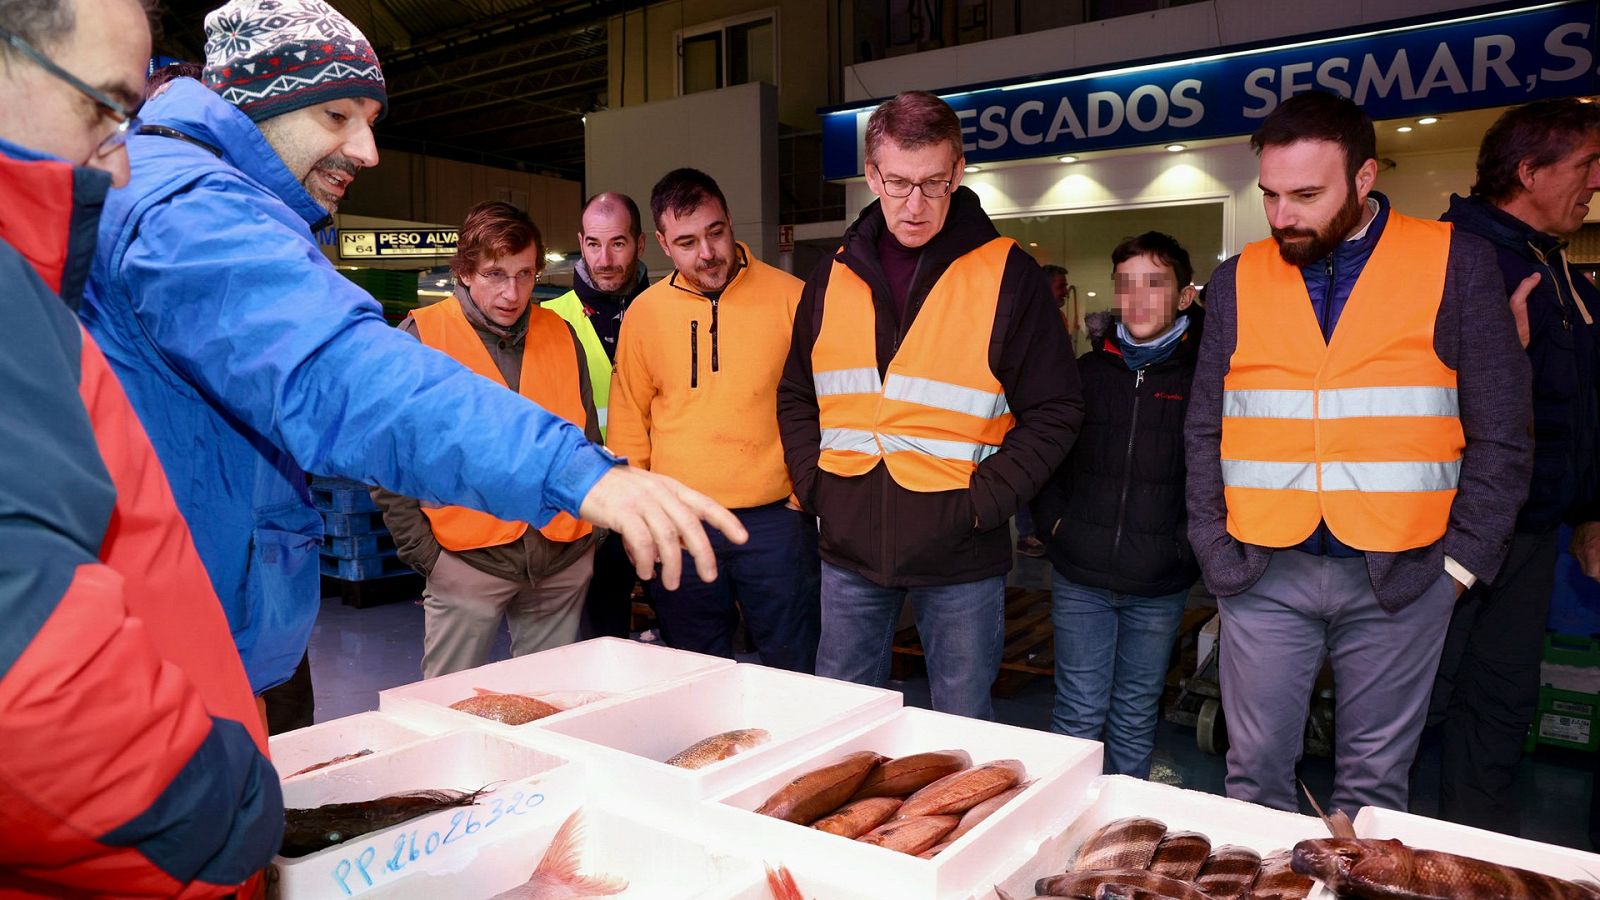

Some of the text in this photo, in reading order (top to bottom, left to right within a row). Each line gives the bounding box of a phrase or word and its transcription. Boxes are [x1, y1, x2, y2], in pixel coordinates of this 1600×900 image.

[957, 79, 1206, 152] ESCADOS
[379, 232, 460, 245] PESO ALVA
[355, 245, 374, 254] 64
